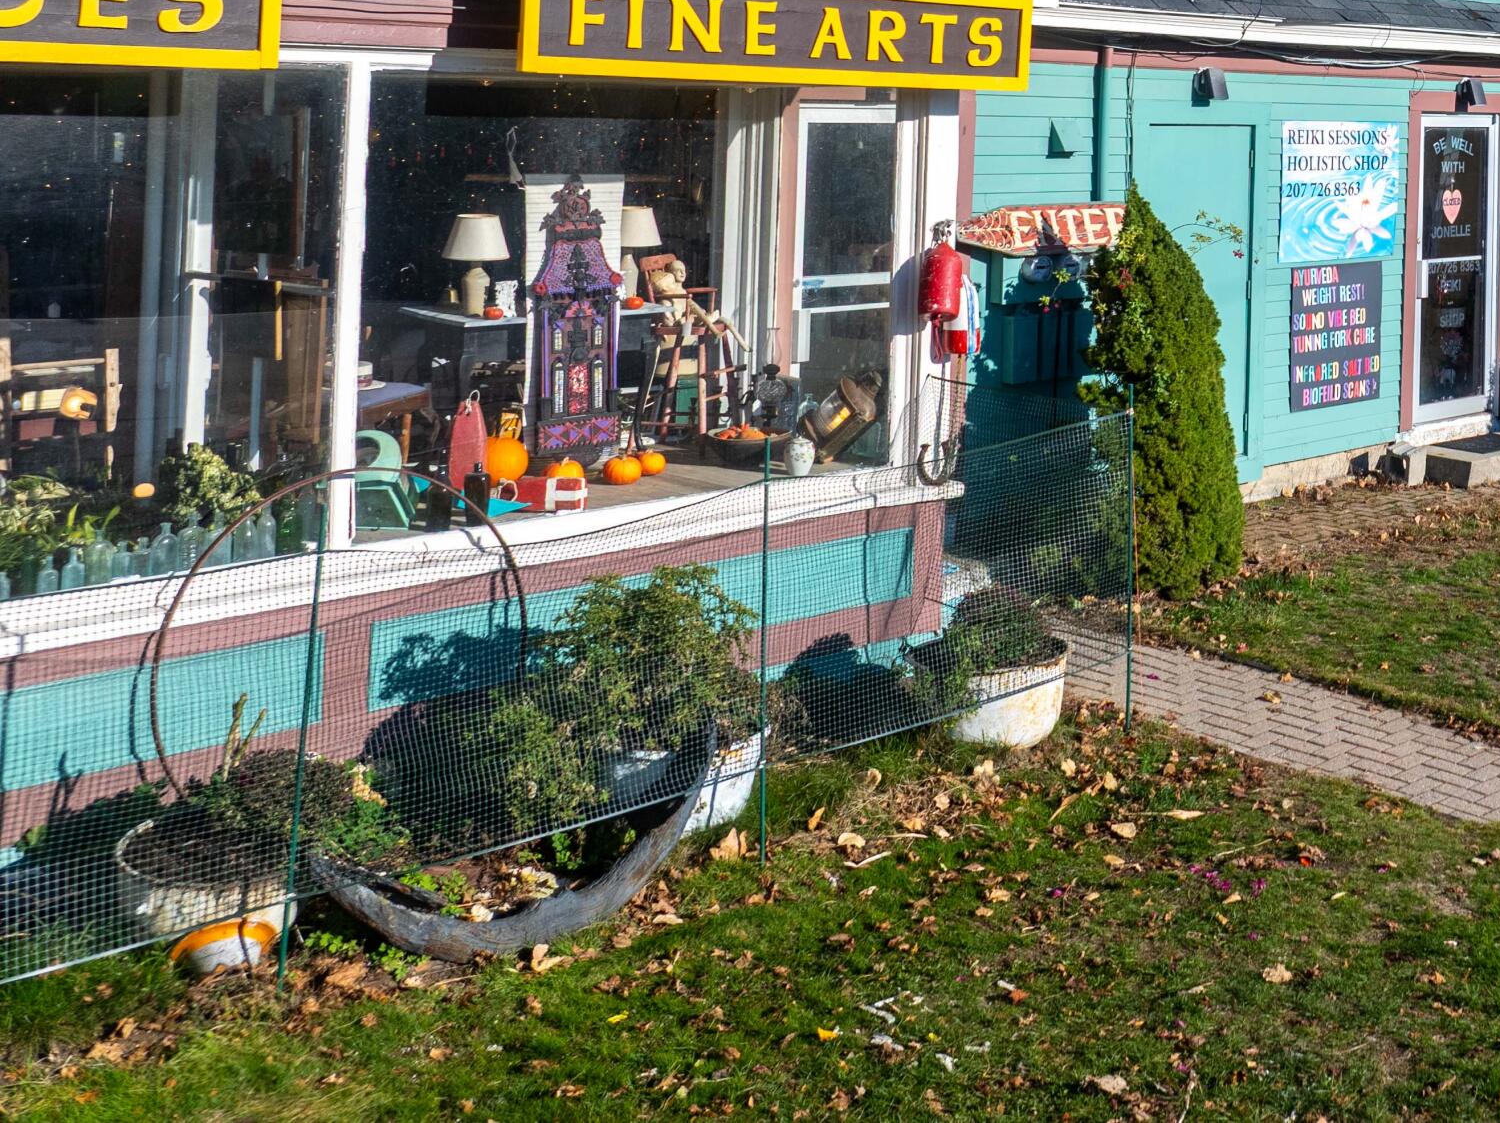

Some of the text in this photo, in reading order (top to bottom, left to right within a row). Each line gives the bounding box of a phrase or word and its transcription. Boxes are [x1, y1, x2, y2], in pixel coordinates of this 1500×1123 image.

[809, 7, 1004, 67] ARTS
[1287, 129, 1387, 146] REIKI SESSIONS
[1433, 135, 1474, 156] BE WELL
[1286, 155, 1388, 171] HOLISTIC SHOP
[1441, 161, 1465, 173] WITH
[1286, 181, 1361, 197] 207 726 8363
[1007, 208, 1125, 249] ENTER
[1431, 224, 1471, 239] JONELLE
[1293, 266, 1339, 287] AYURVEDA
[1302, 284, 1365, 306] WEIGHT REST!
[1293, 308, 1366, 331] SOUND VIBE BED
[1293, 327, 1376, 353] TUNING FORK CURE
[1293, 355, 1380, 383] INFRARED SALT BED
[1302, 383, 1341, 406] BIOFEILD
